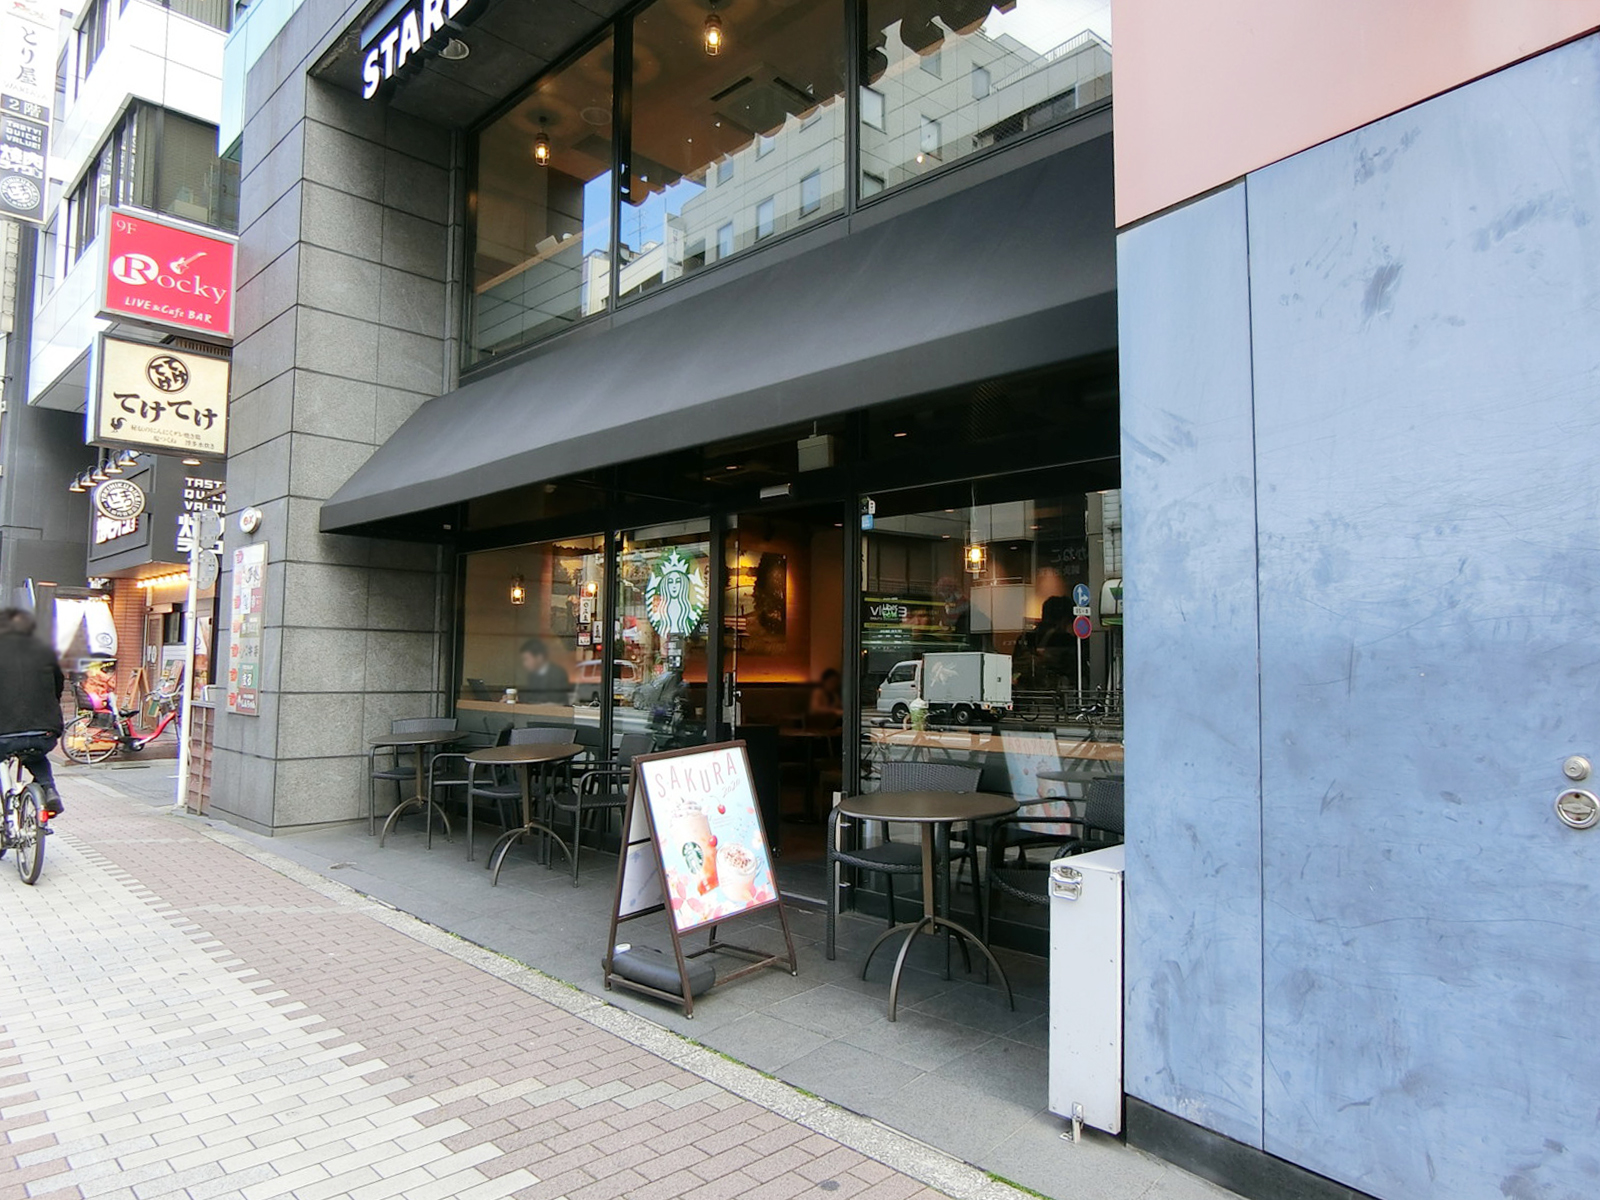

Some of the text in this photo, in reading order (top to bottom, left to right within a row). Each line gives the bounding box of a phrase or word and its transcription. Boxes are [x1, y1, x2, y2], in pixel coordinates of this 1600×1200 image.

[16, 26, 38, 86] とり屋
[8, 98, 41, 118] 2階
[5, 127, 42, 143] QUICK!
[6, 119, 42, 136] TASTY!
[5, 134, 41, 150] VALUE!
[116, 219, 137, 235] 9F
[113, 253, 227, 305] Rocky
[188, 310, 212, 324] BAR
[113, 391, 218, 431] てけてけ
[185, 477, 226, 490] TAST
[655, 752, 737, 798] SAKURA
